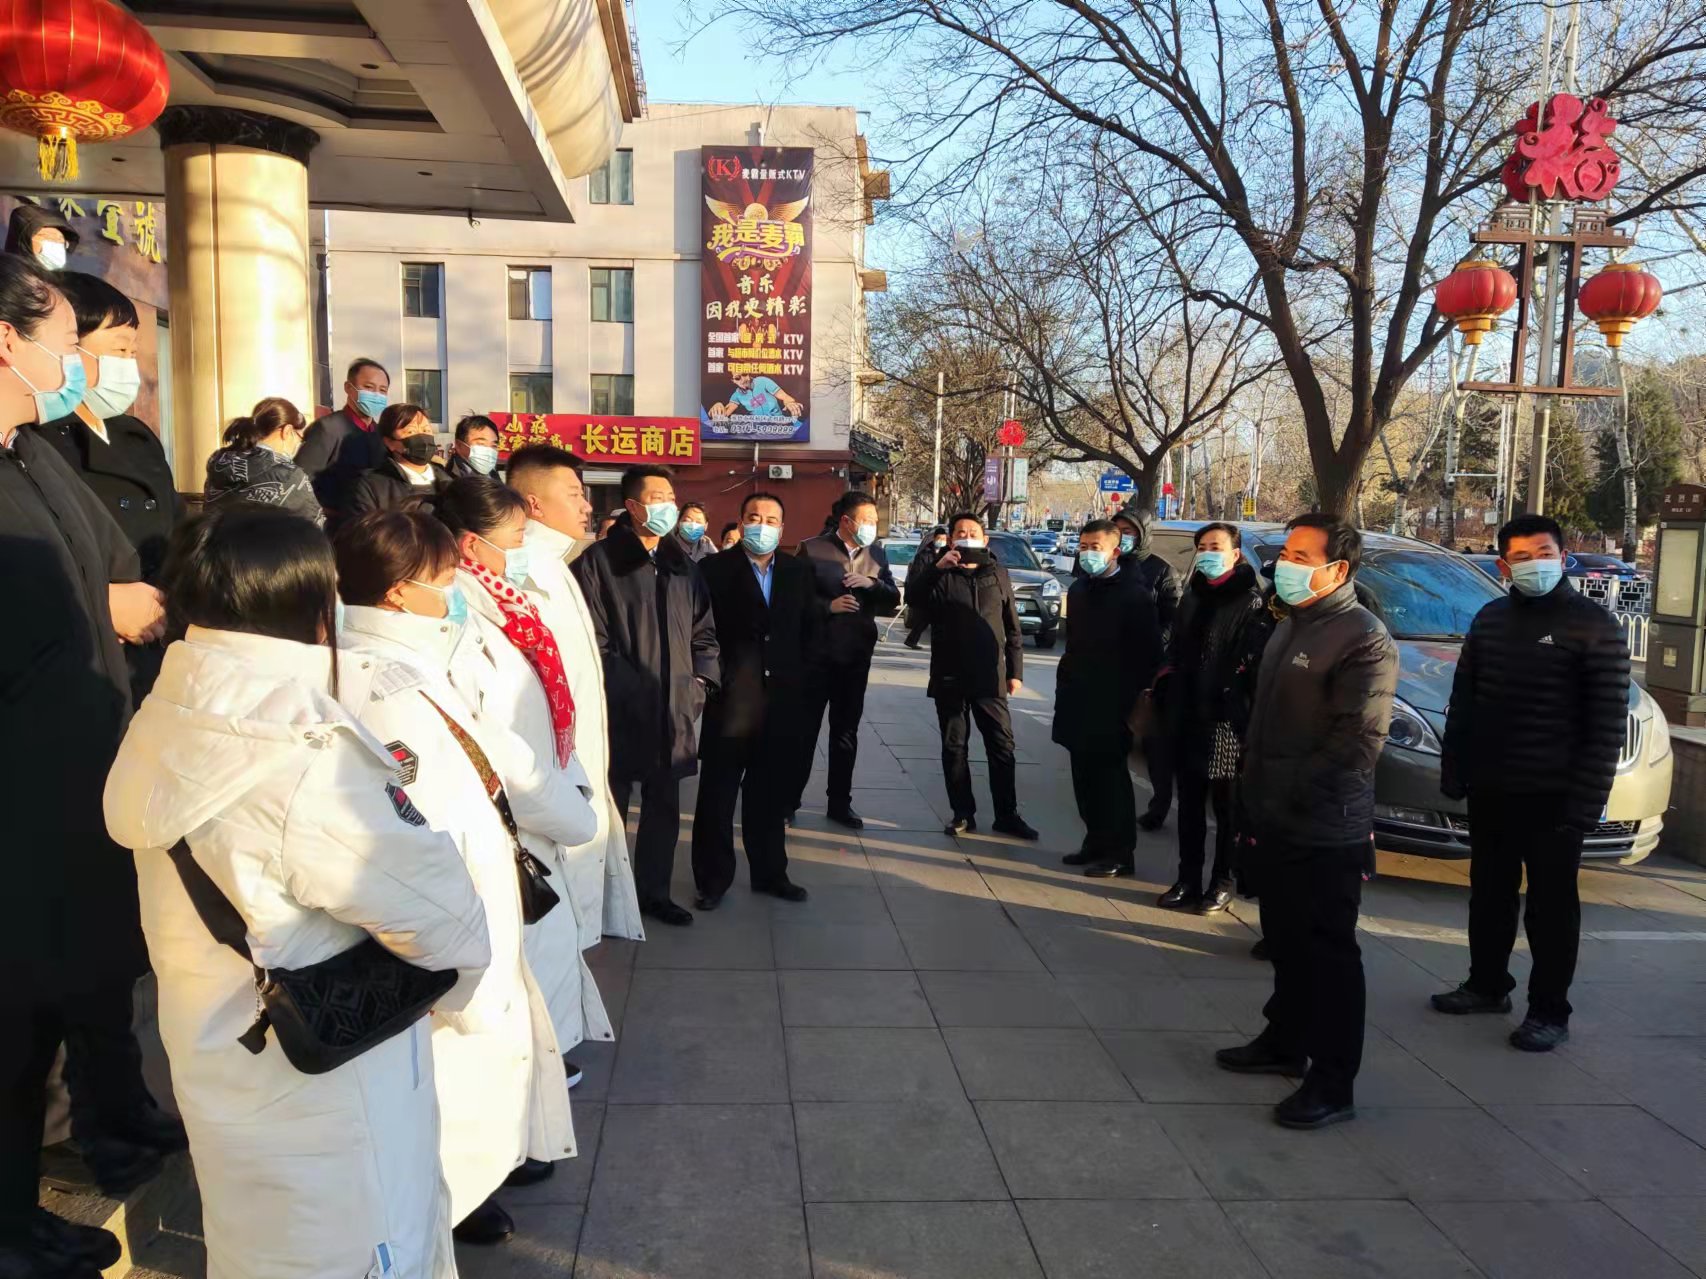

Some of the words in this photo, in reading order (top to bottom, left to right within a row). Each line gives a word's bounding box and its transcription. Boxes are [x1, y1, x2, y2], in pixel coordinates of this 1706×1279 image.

[736, 273, 775, 295] 音乐
[706, 295, 807, 321] 因我更精彩
[783, 333, 804, 345] KTV
[783, 349, 803, 361] KTV
[783, 364, 804, 376] KTV
[580, 423, 695, 457] 长运商店
